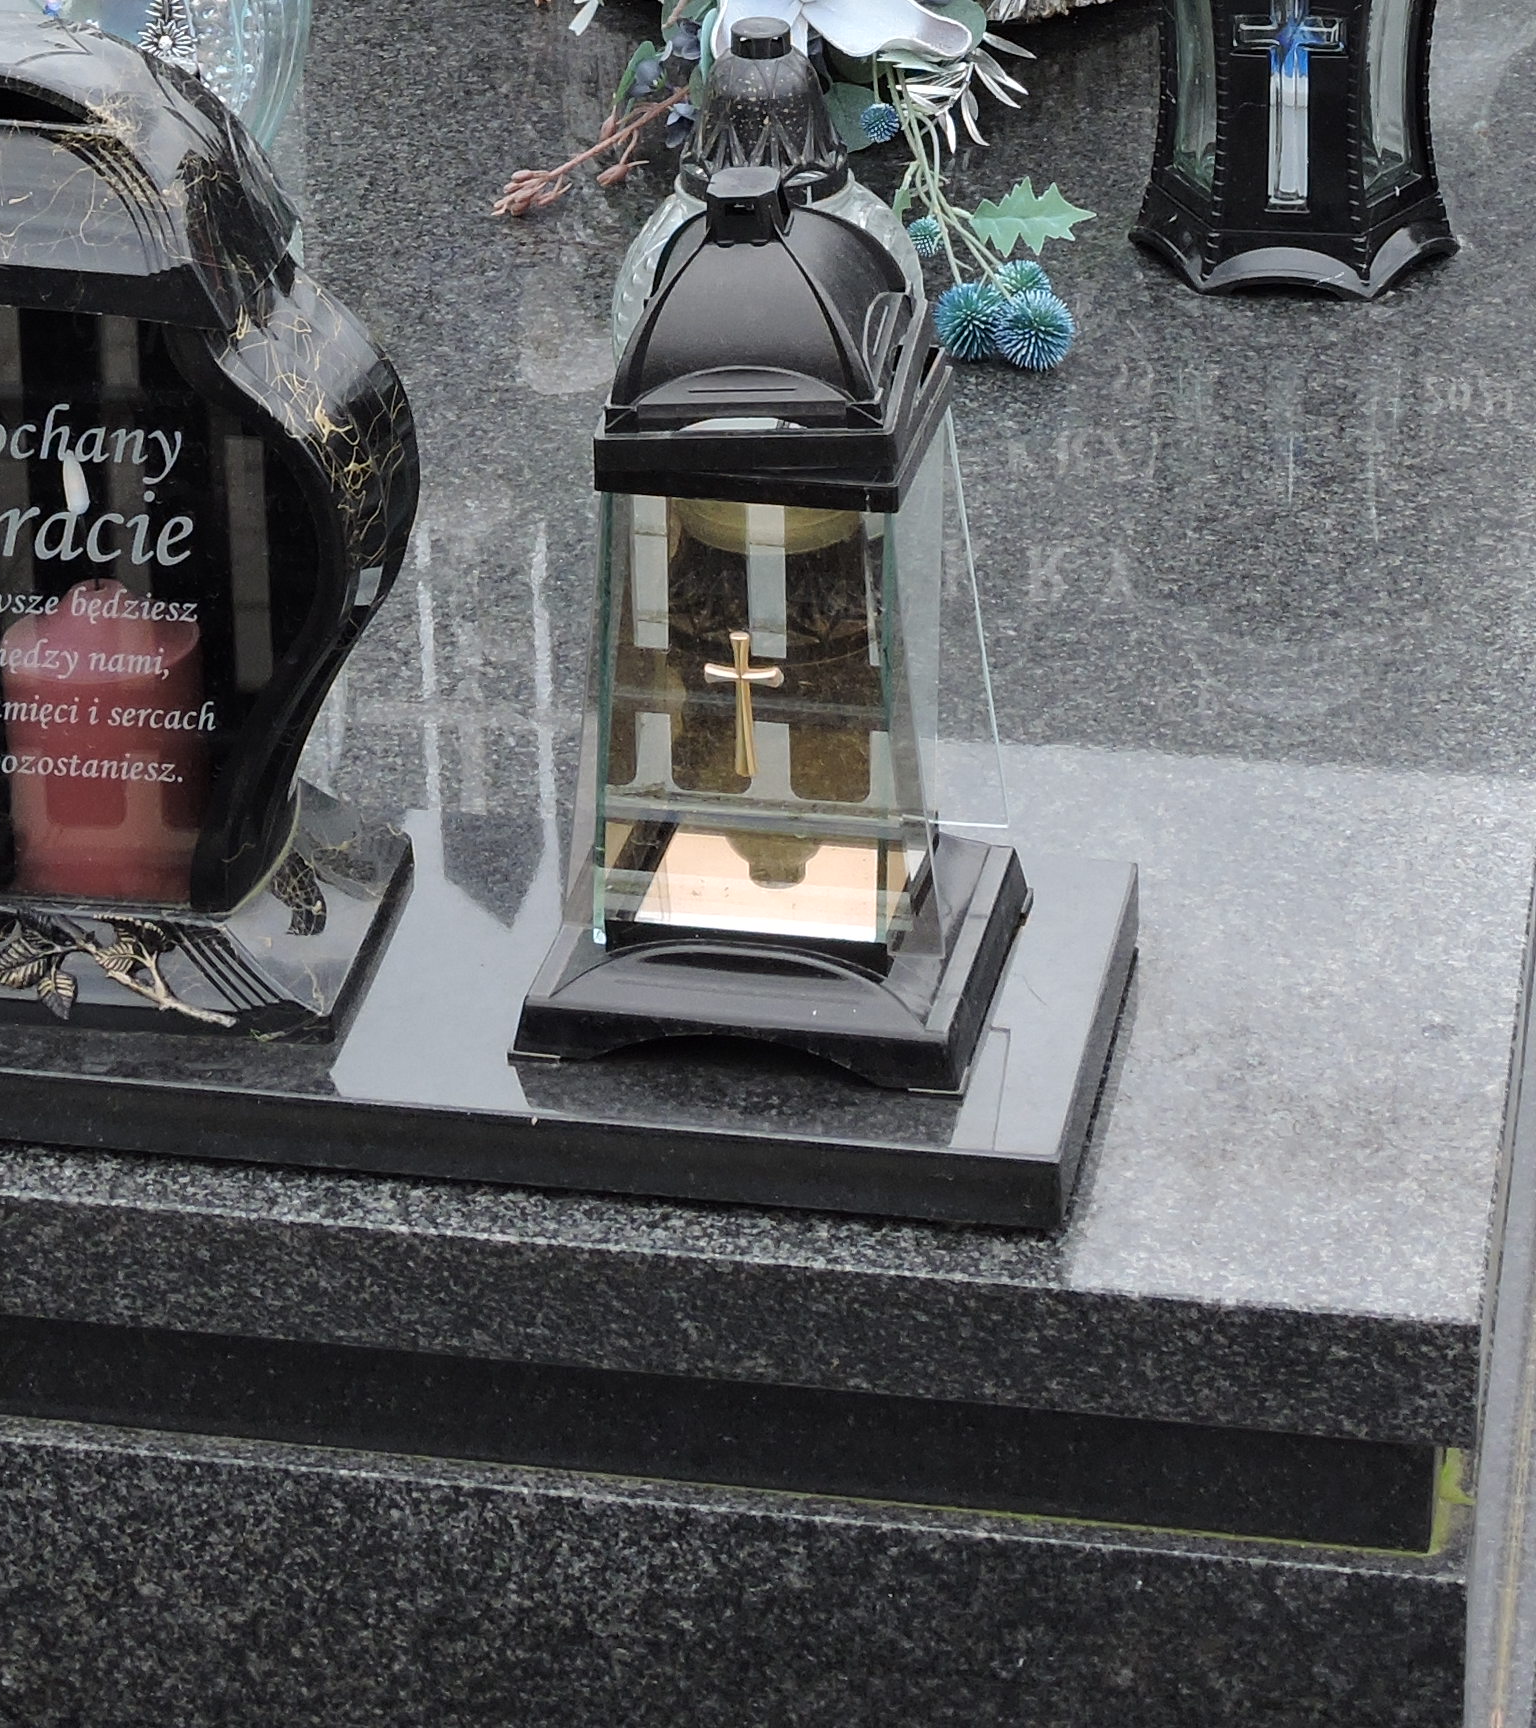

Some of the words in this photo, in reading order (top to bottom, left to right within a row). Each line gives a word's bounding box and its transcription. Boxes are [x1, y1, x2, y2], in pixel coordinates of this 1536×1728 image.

[70, 586, 198, 625] będziesz
[89, 647, 170, 681] nami,
[89, 697, 99, 725] i
[107, 701, 216, 732] sercach
